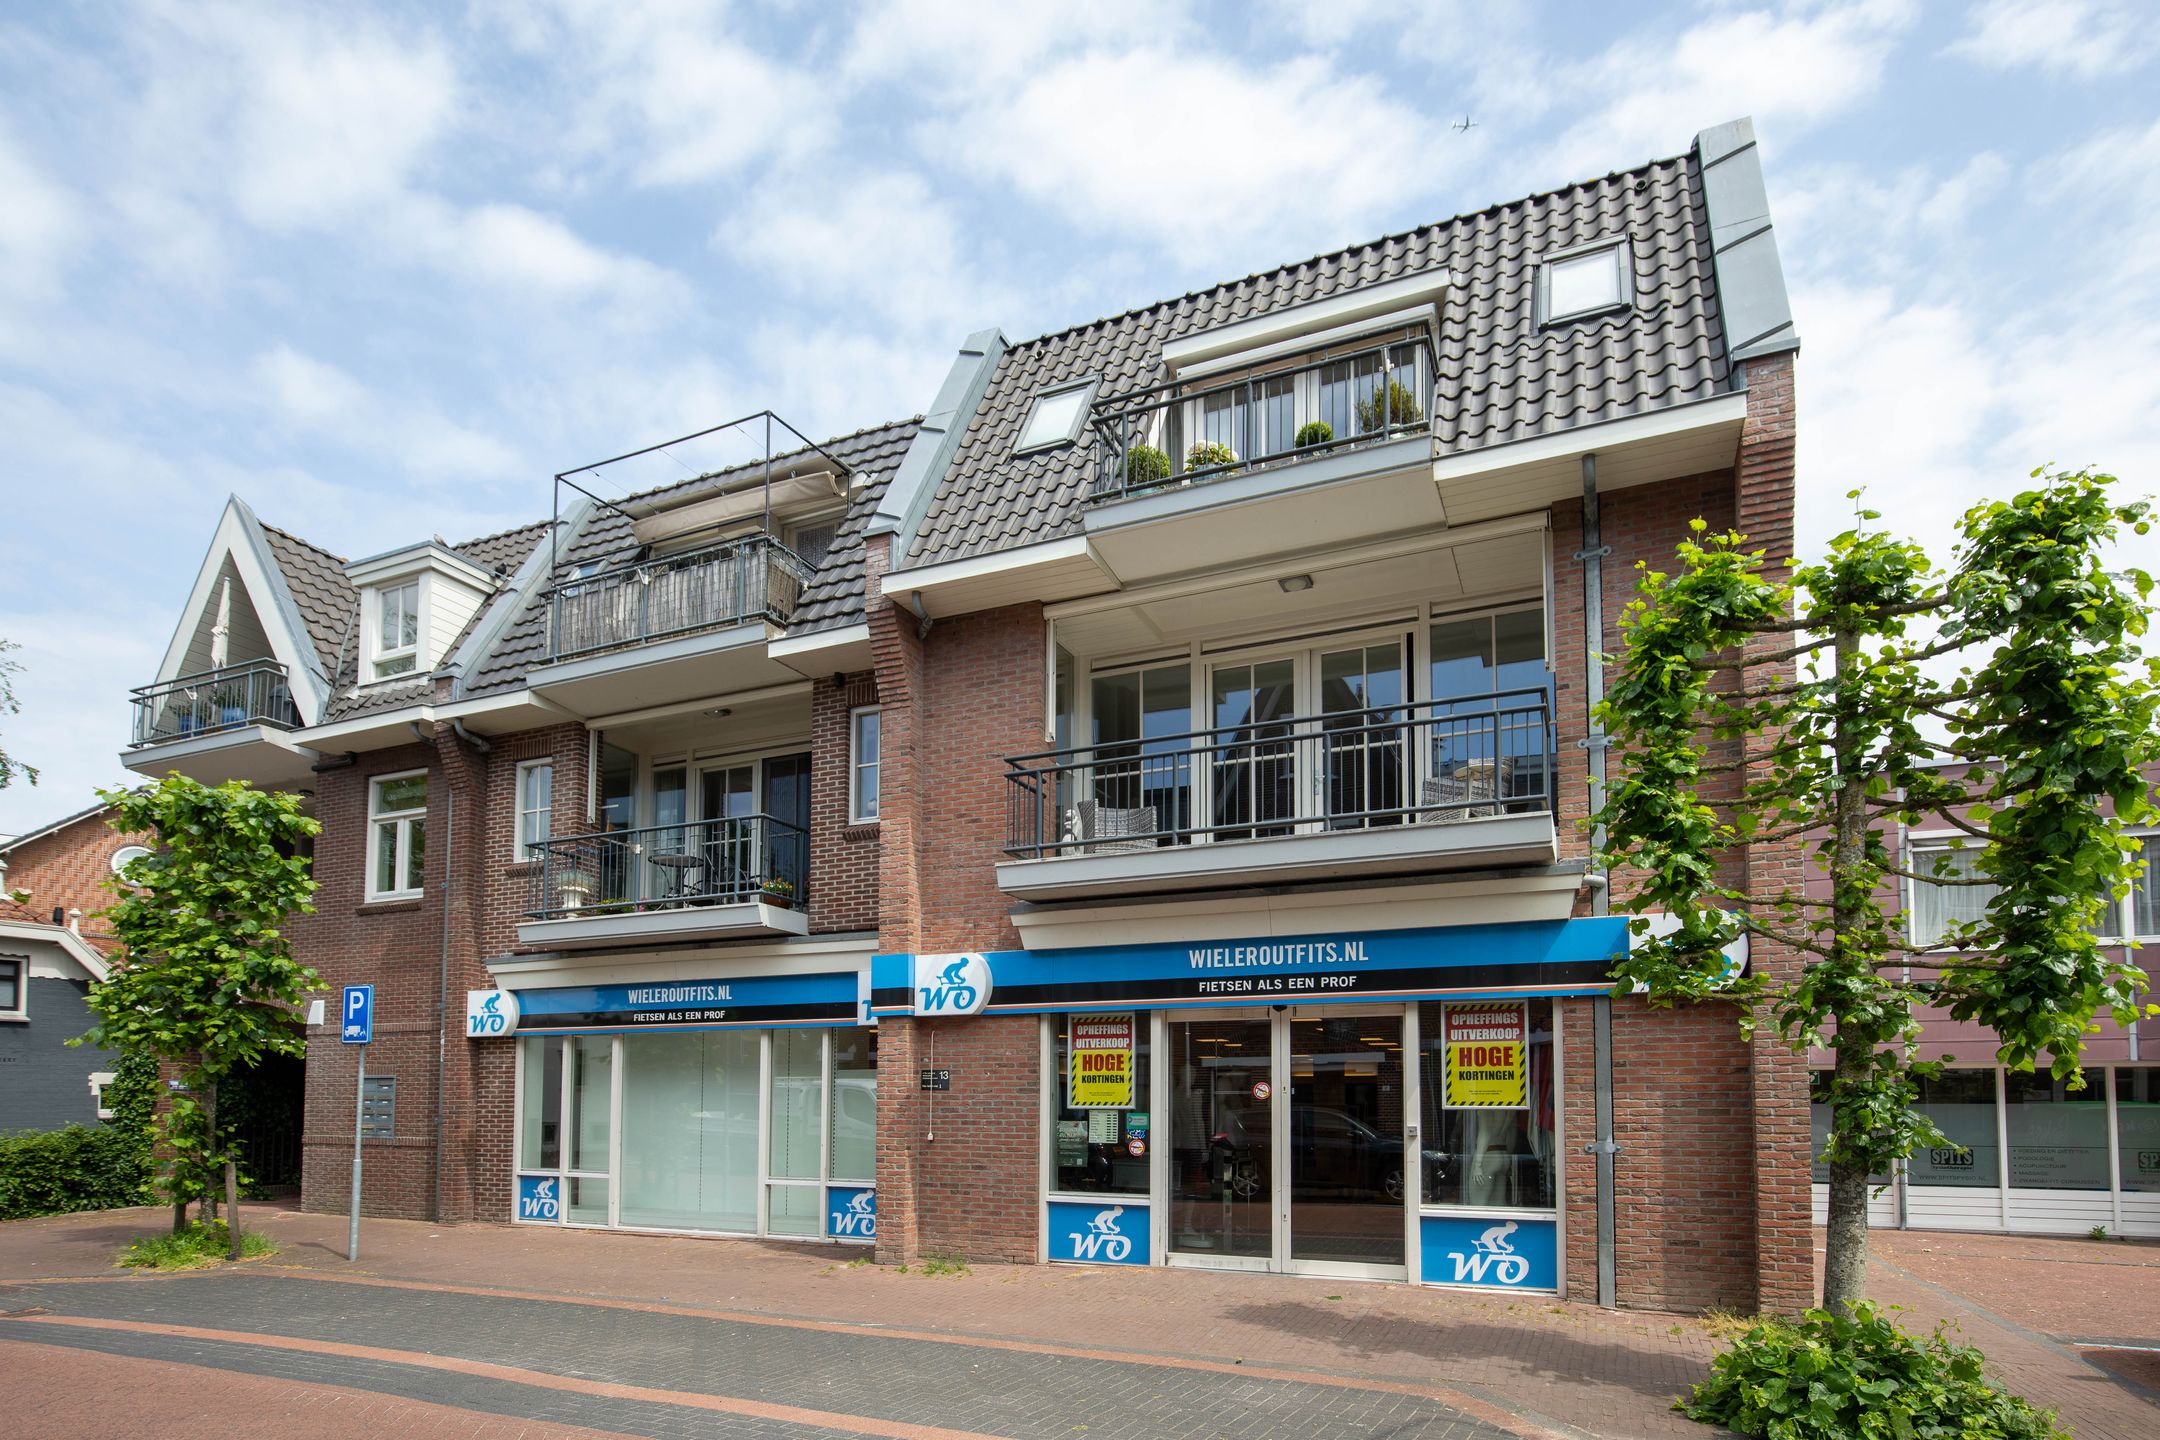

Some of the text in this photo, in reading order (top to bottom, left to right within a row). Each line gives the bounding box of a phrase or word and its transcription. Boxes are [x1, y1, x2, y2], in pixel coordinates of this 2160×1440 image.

[1188, 941, 1369, 969] WIELEROUTFITS.NL
[1199, 975, 1357, 993] FIETSEN ALS EEN PROF
[627, 985, 733, 1004] WIELEROUTFITS.NL
[348, 991, 365, 1020] P
[633, 1010, 726, 1022] FIETSEN ALS EEN PROF
[1451, 1012, 1518, 1026] OPHEFFINGS
[1077, 1024, 1129, 1035] OPHEFFINGS
[1450, 1028, 1520, 1041] UITVERKOOP
[1076, 1037, 1130, 1049] UITVERKOOP
[1082, 1053, 1125, 1072] HOGE
[1458, 1046, 1514, 1067] HOGE
[939, 1070, 949, 1080] 13
[1081, 1074, 1125, 1084] KORTINGEN
[1458, 1070, 1515, 1081] KORTINGEN
[1932, 1150, 1972, 1164] SPITS
